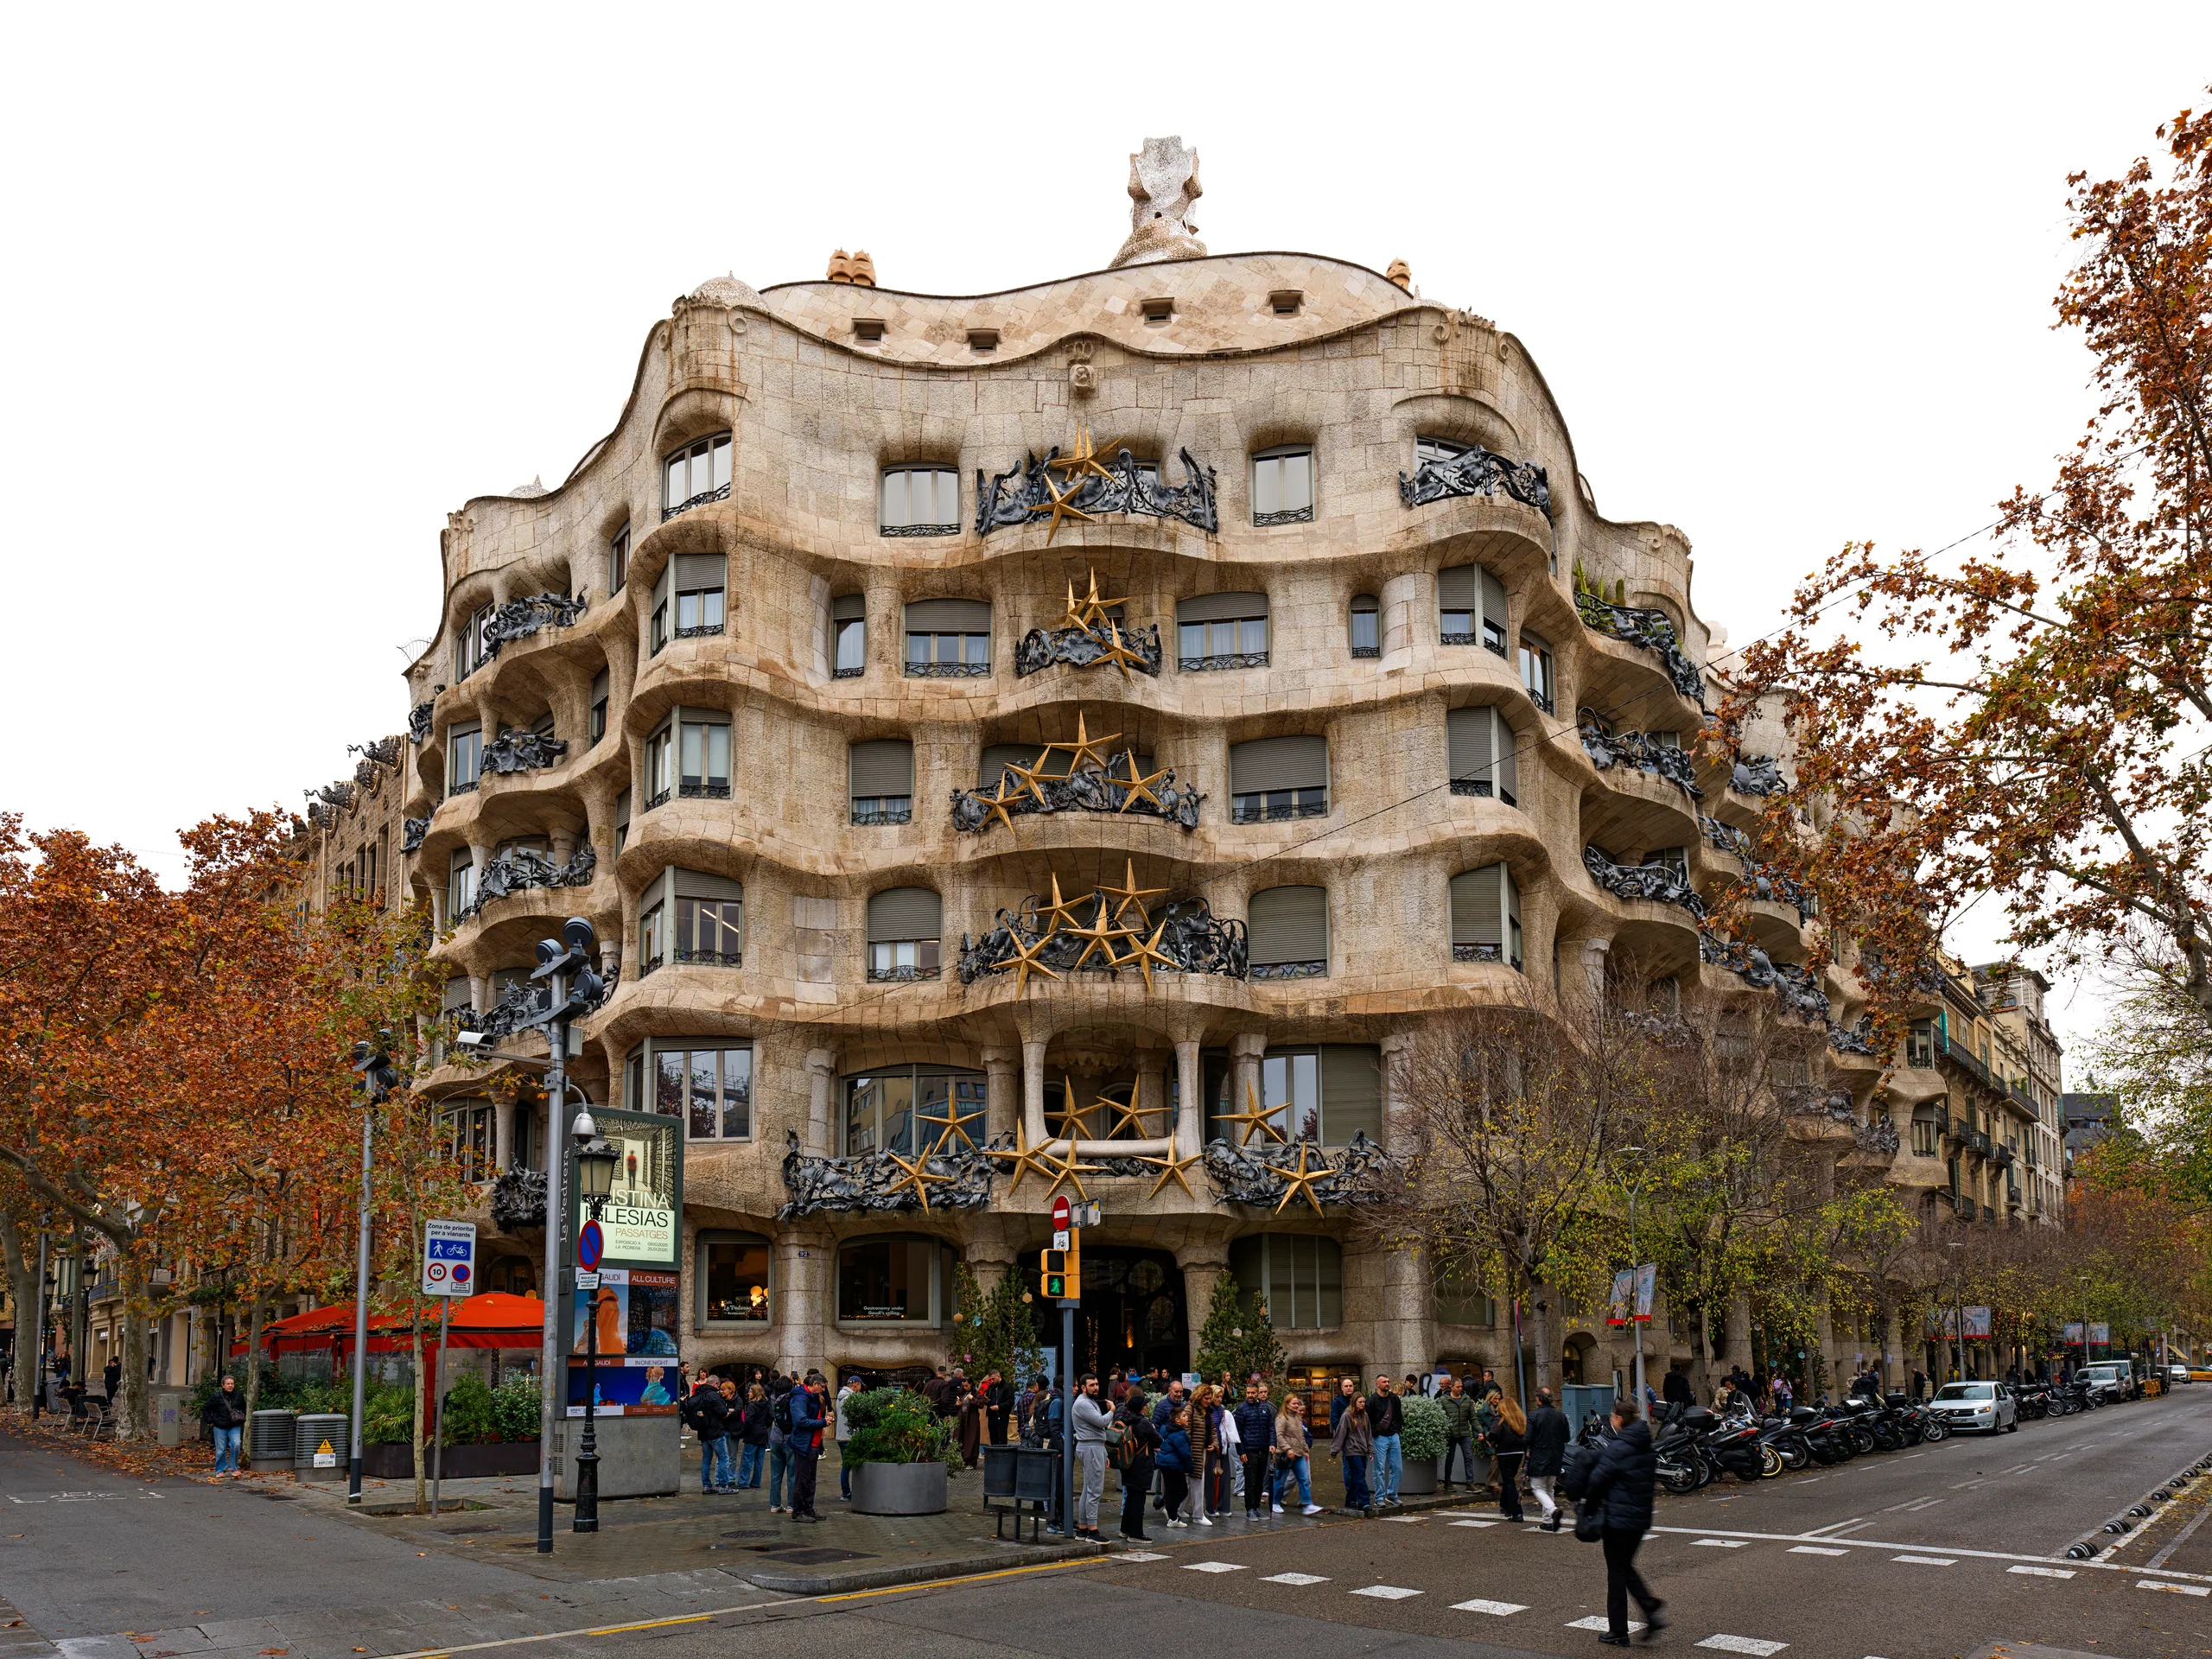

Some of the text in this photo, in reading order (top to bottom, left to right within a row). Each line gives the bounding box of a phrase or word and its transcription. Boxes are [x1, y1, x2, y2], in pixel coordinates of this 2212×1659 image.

[560, 1147, 569, 1243] La Pedrera
[607, 1189, 669, 1209] ISTINA
[615, 1227, 668, 1240] PASSATGES
